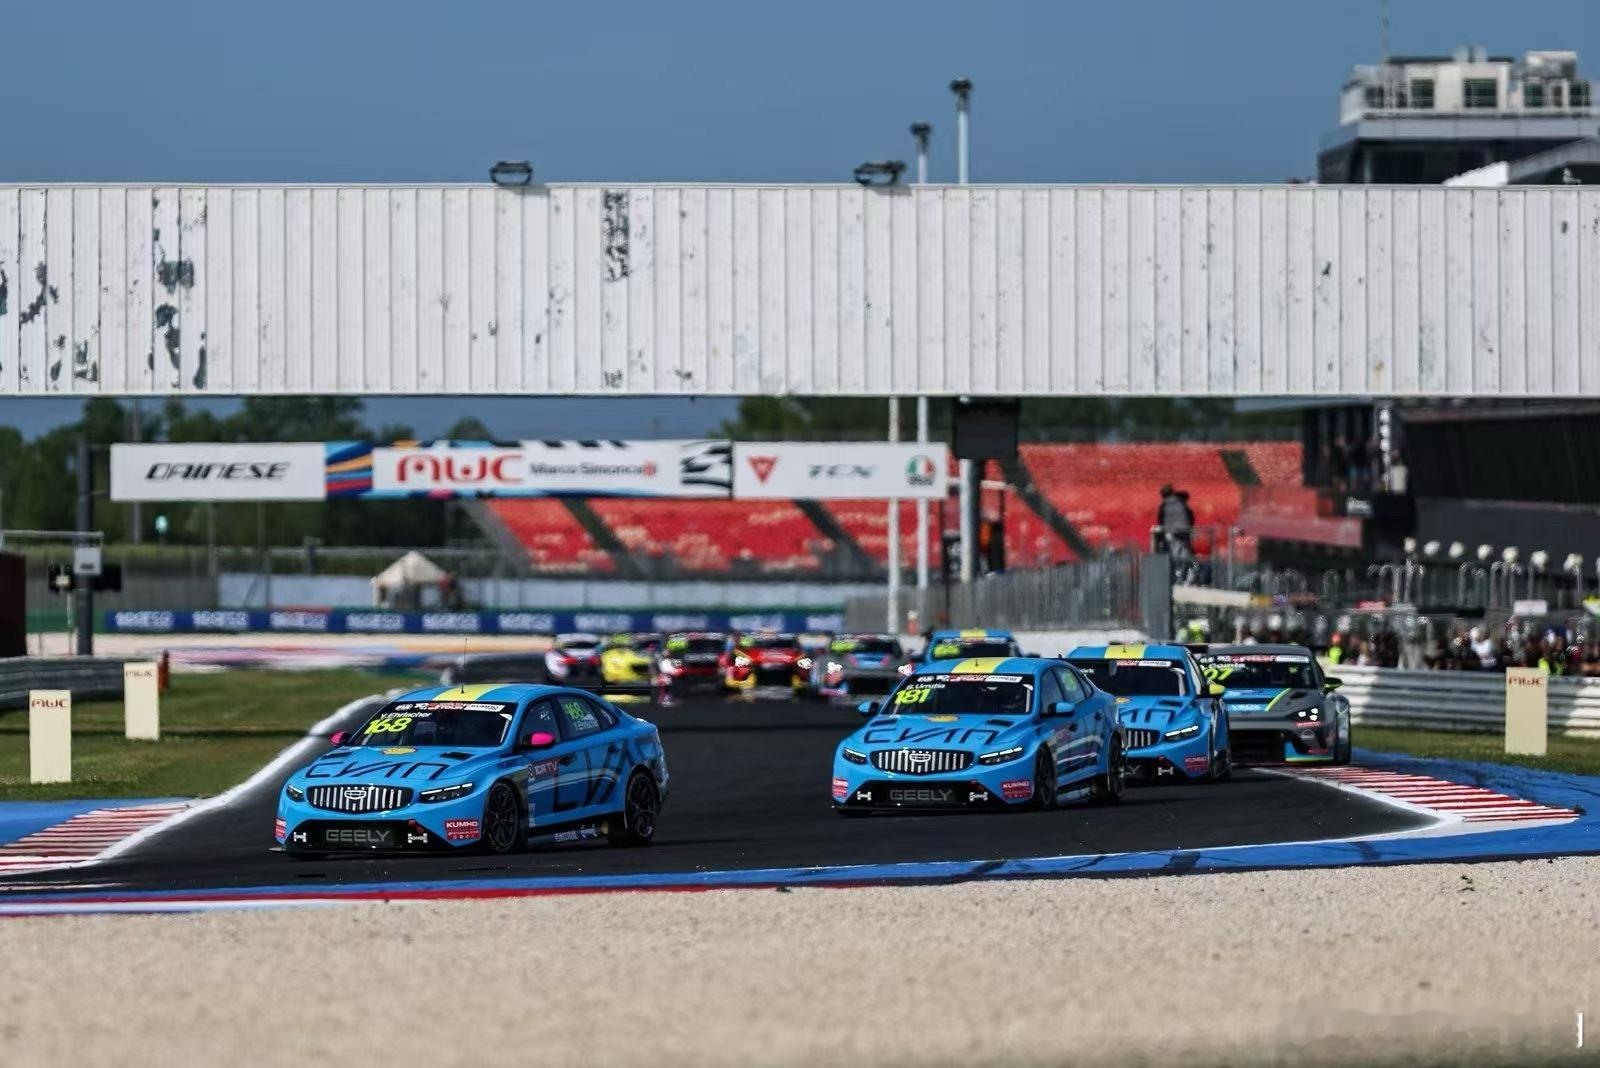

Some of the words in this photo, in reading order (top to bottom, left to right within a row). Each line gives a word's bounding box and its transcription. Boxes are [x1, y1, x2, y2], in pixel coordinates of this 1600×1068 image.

[146, 462, 290, 480] DAINESE
[894, 688, 931, 704] 181
[364, 717, 413, 735] 168
[889, 789, 953, 801] GEELY
[325, 829, 391, 843] GEELY
